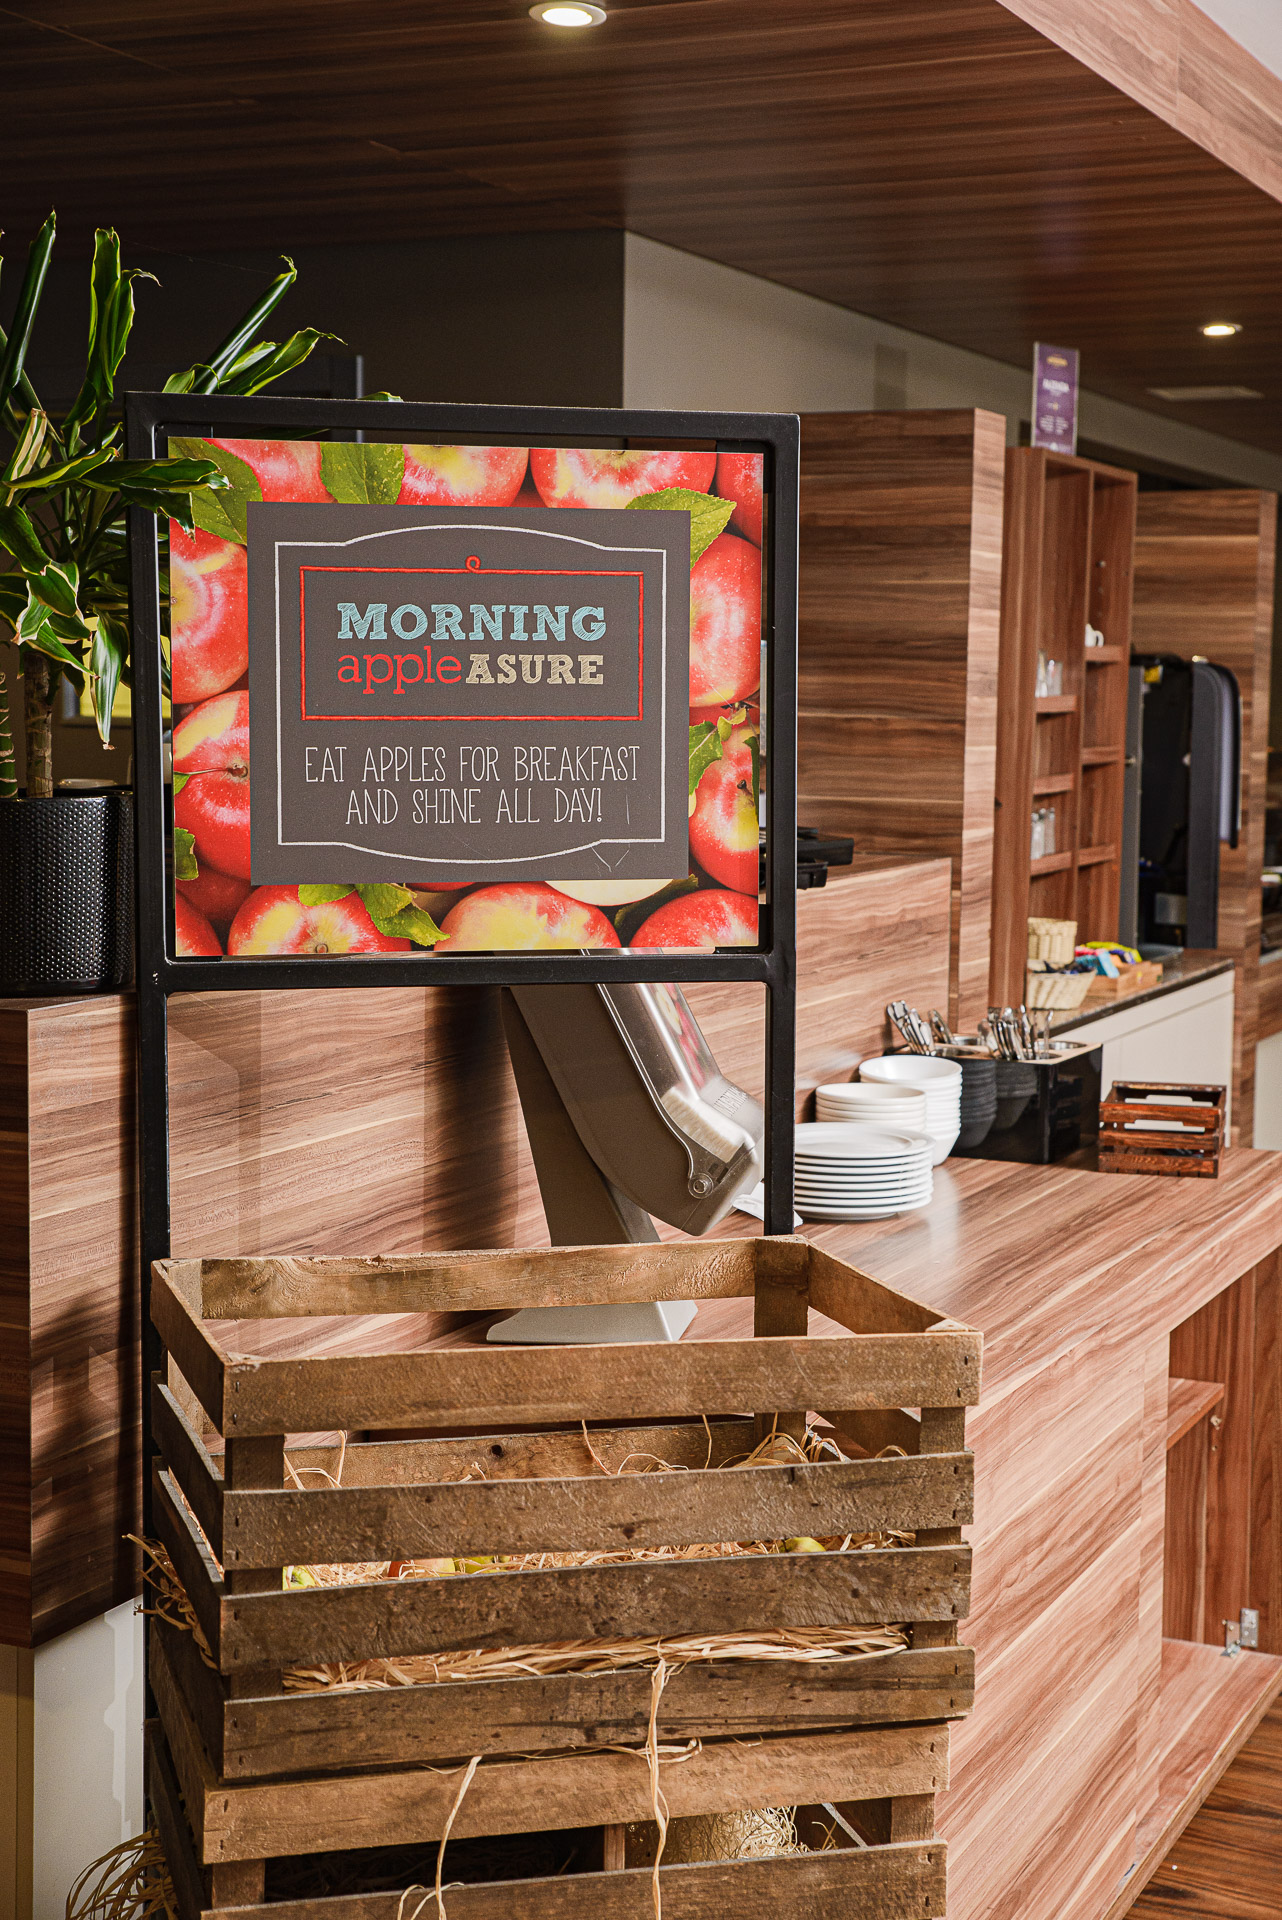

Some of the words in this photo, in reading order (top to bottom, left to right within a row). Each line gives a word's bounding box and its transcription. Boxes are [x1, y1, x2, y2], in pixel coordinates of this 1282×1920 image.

[337, 602, 607, 642] MORNING
[304, 746, 347, 783] EAT
[362, 746, 446, 782] APPLES
[459, 746, 501, 782] FOR
[514, 746, 640, 782] BREAKFAST
[345, 788, 399, 825] AND
[412, 788, 481, 824] SHINE
[495, 787, 540, 824] ALL
[553, 787, 603, 824] DAY!
